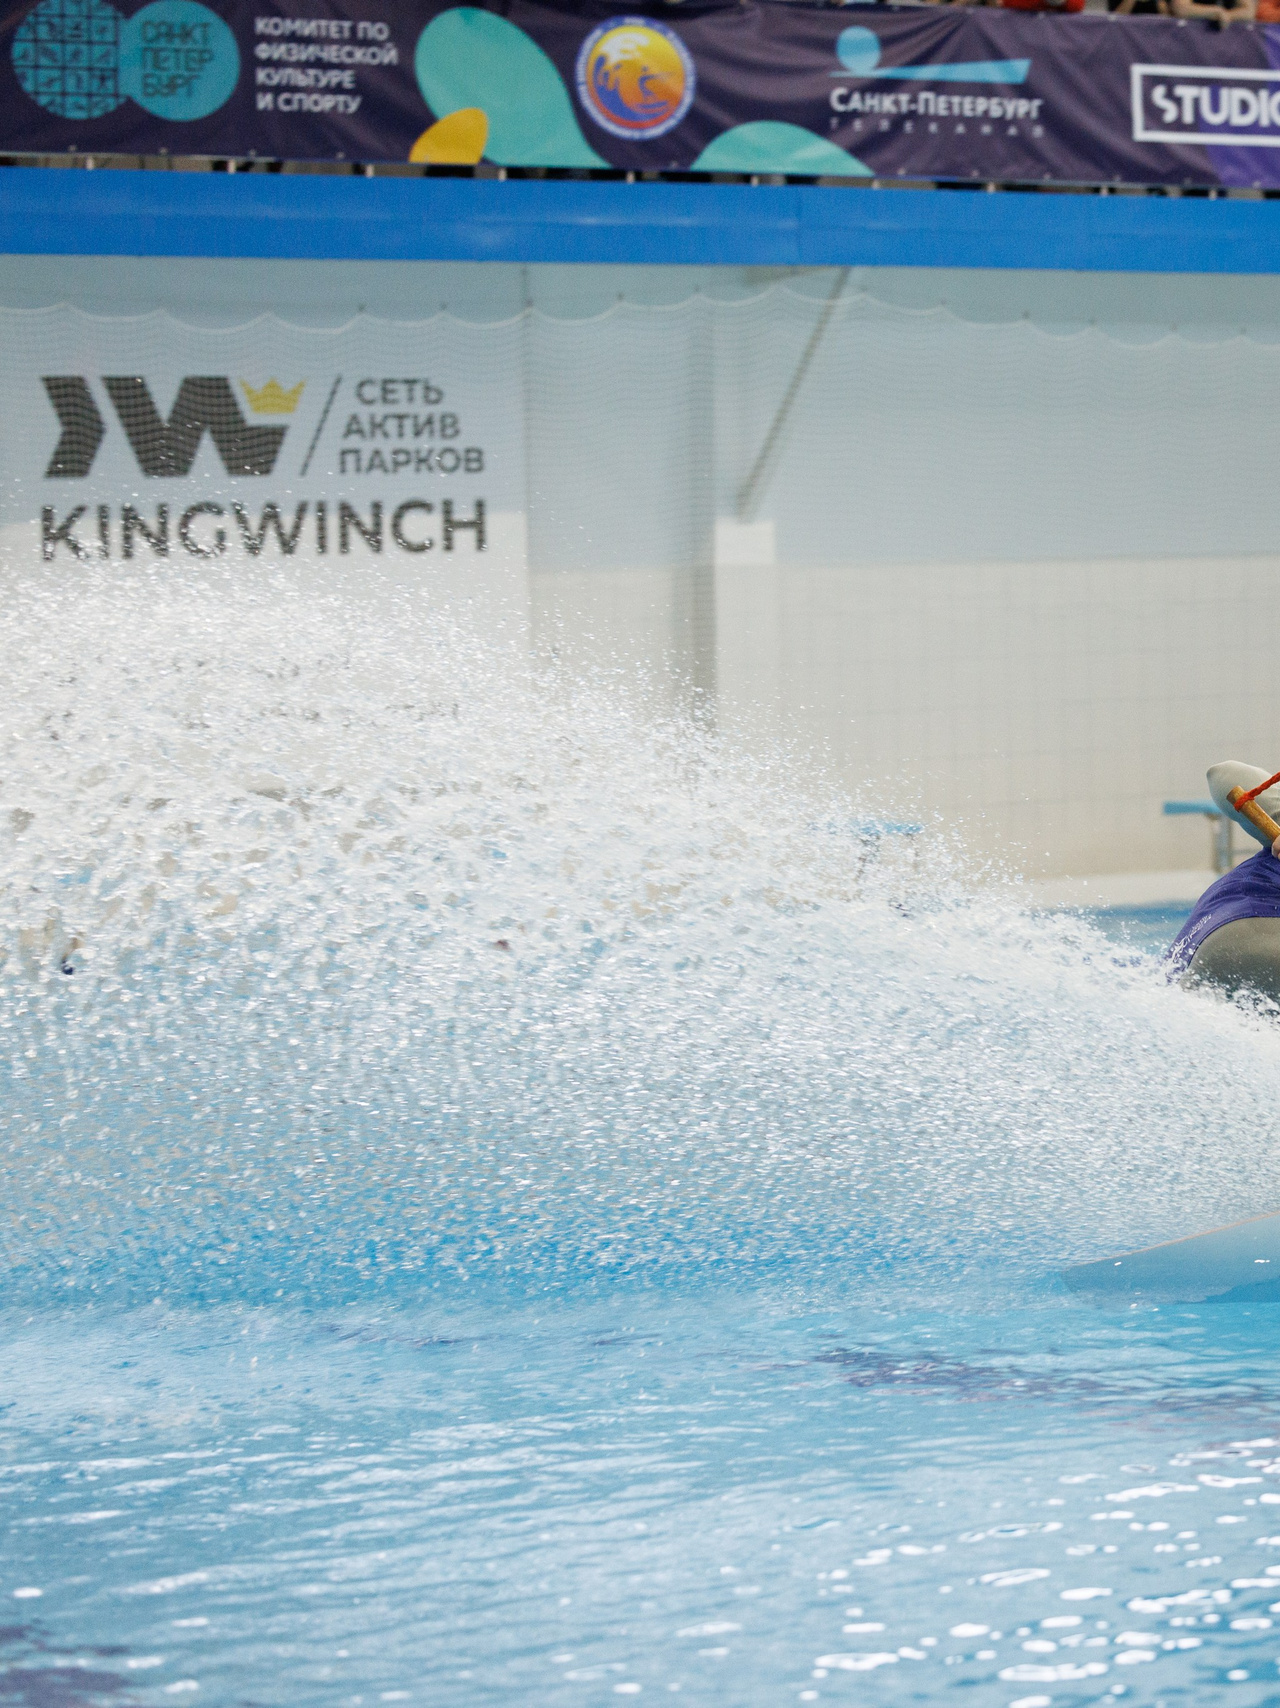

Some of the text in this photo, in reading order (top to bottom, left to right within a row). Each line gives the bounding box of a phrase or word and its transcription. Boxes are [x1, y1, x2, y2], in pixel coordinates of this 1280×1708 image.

[254, 16, 389, 41] КОМИТЕТ ПО
[254, 41, 399, 66] ФИЗИЧЕСКОЙ
[255, 66, 356, 90] КУЛЬТУРЕ
[256, 91, 362, 114] И СПОРТУ
[356, 377, 444, 406] СЕТЬ
[343, 412, 461, 441] АКТИВ
[339, 446, 485, 475] ПАРКОВ
[40, 499, 488, 561] KINGWINCH
